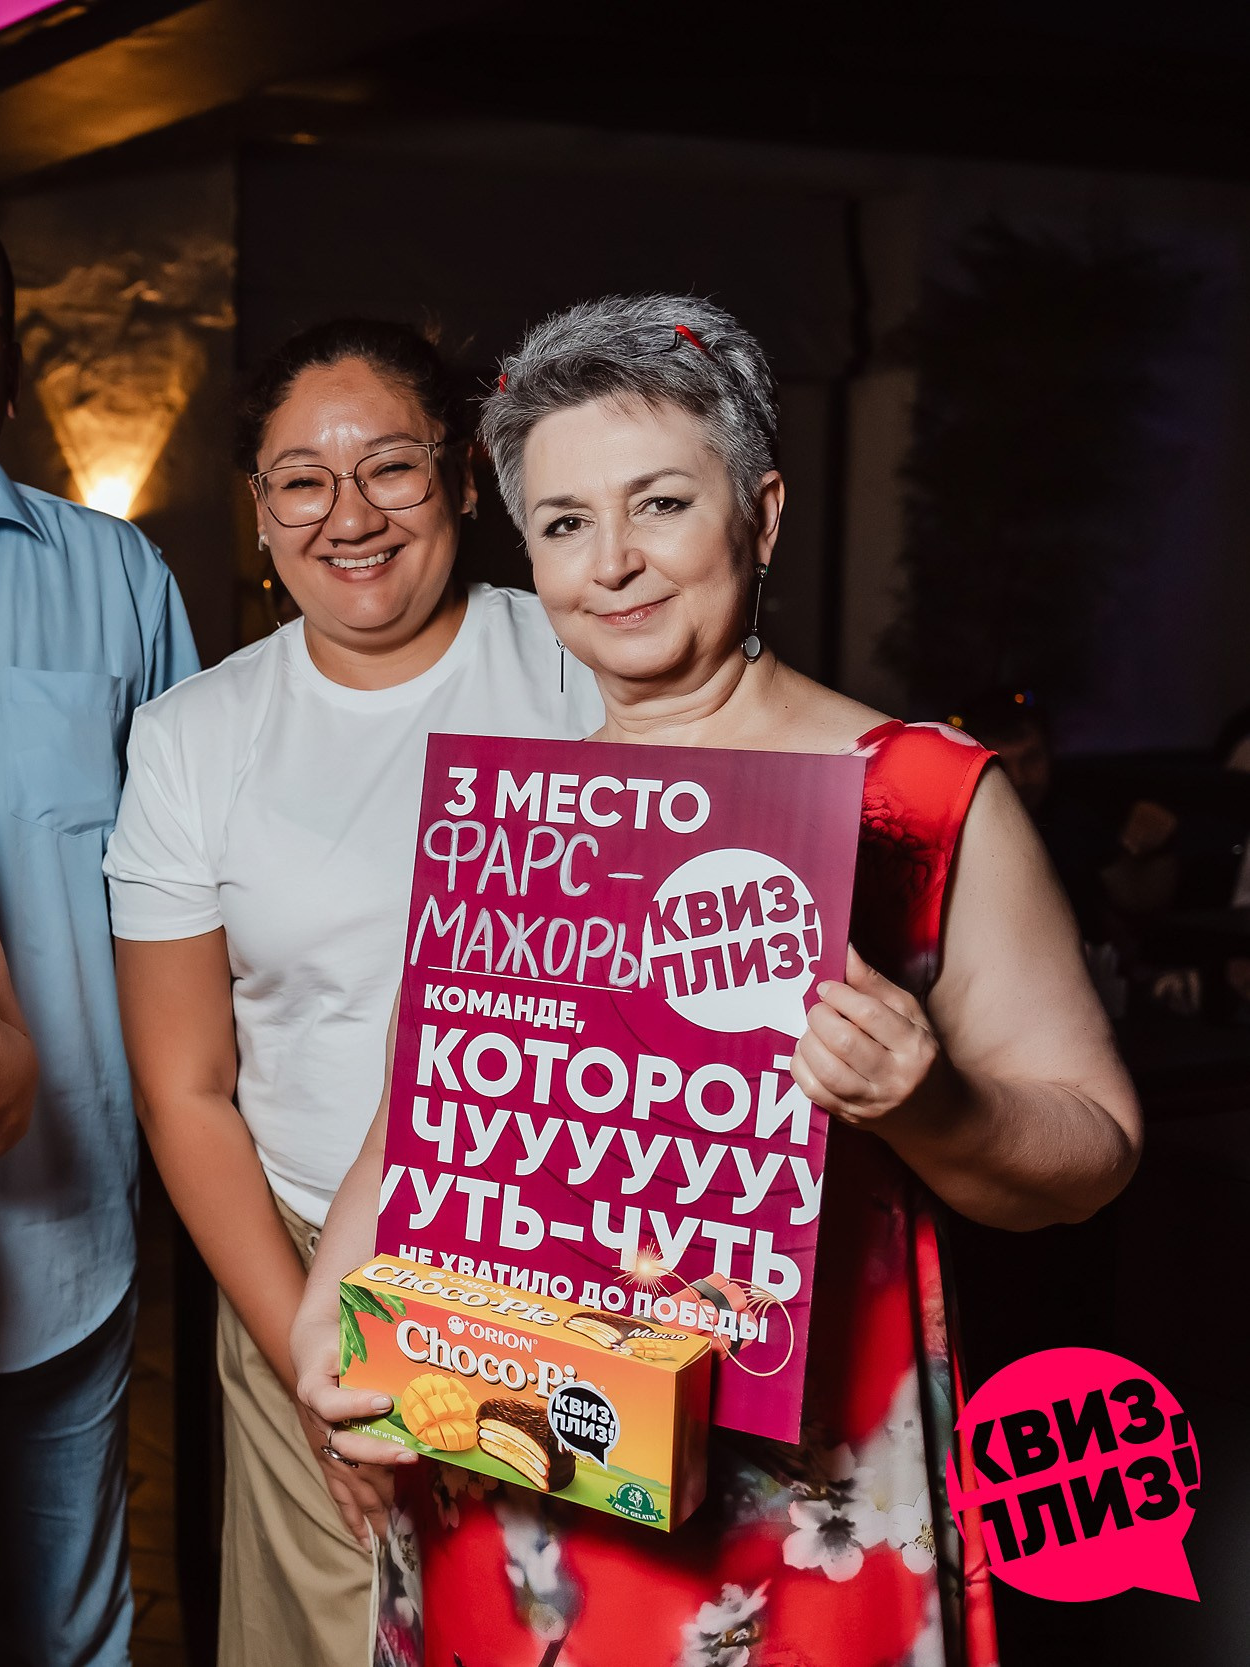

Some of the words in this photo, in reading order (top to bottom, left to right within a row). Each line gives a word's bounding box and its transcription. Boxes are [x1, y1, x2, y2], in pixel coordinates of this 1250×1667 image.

[443, 767, 476, 816] 3
[495, 769, 711, 834] МЕСТО
[650, 875, 816, 946] КВИЗ,
[410, 894, 649, 989] МАЖОРЫ
[650, 928, 821, 998] ПЛИЗ!
[424, 985, 586, 1034] КОМАНДЕ,
[416, 1024, 813, 1146] КОТОРОЙ
[439, 1251, 574, 1301] ХВАТИЛО
[579, 1280, 626, 1312] ДО
[632, 1291, 768, 1344] ПОБЕДЫ
[450, 1277, 509, 1297] ORION
[469, 1323, 534, 1353] ORION
[552, 1411, 615, 1445] ПЛИЗ!
[555, 1394, 616, 1428] КВИЗ,
[614, 1502, 630, 1515] BEEF
[630, 1510, 657, 1521] GELATIN
